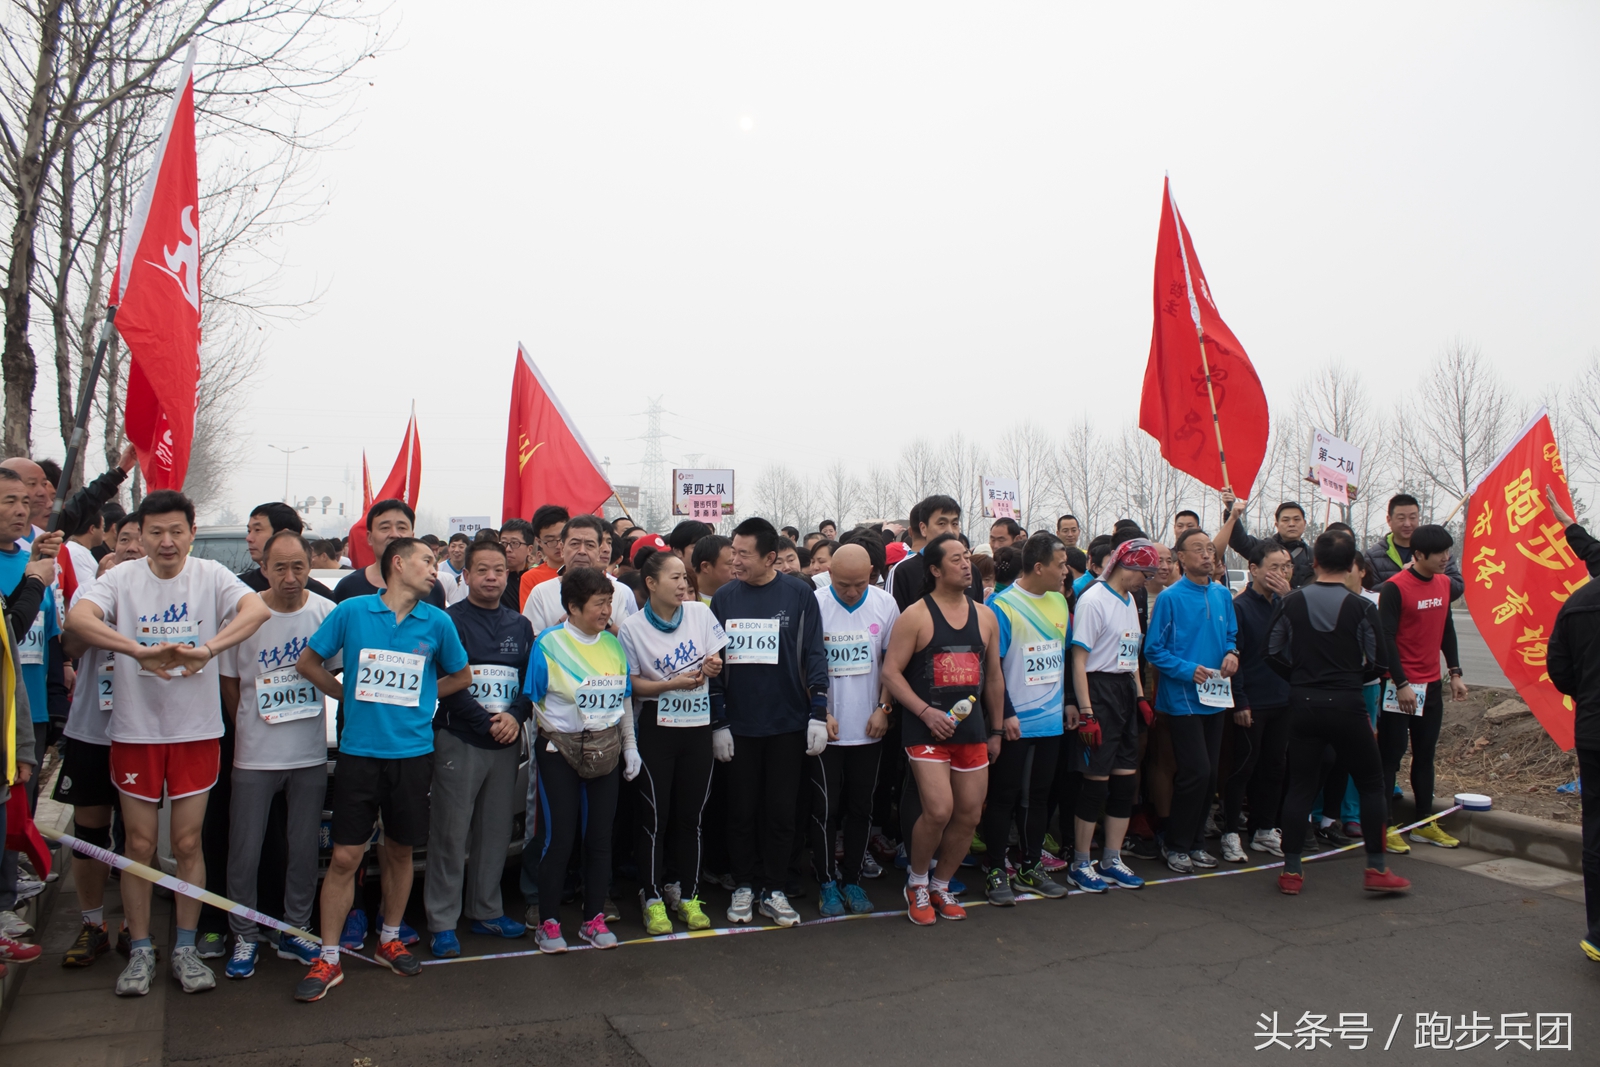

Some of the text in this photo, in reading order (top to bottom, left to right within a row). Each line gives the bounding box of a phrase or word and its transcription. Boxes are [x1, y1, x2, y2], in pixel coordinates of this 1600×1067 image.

[1318, 447, 1354, 475] 第一大队
[683, 483, 726, 495] 第四大队
[989, 489, 1016, 501] 第三大队
[152, 626, 179, 635] B.BON
[727, 635, 777, 650] 29168
[378, 653, 405, 664] B.BON
[1026, 654, 1062, 673] 28989
[274, 674, 299, 684] B.BON
[360, 667, 419, 691] 29212
[260, 686, 318, 709] 29051
[470, 683, 517, 700] 29316
[578, 692, 624, 708] 29125
[660, 696, 709, 713] 29055
